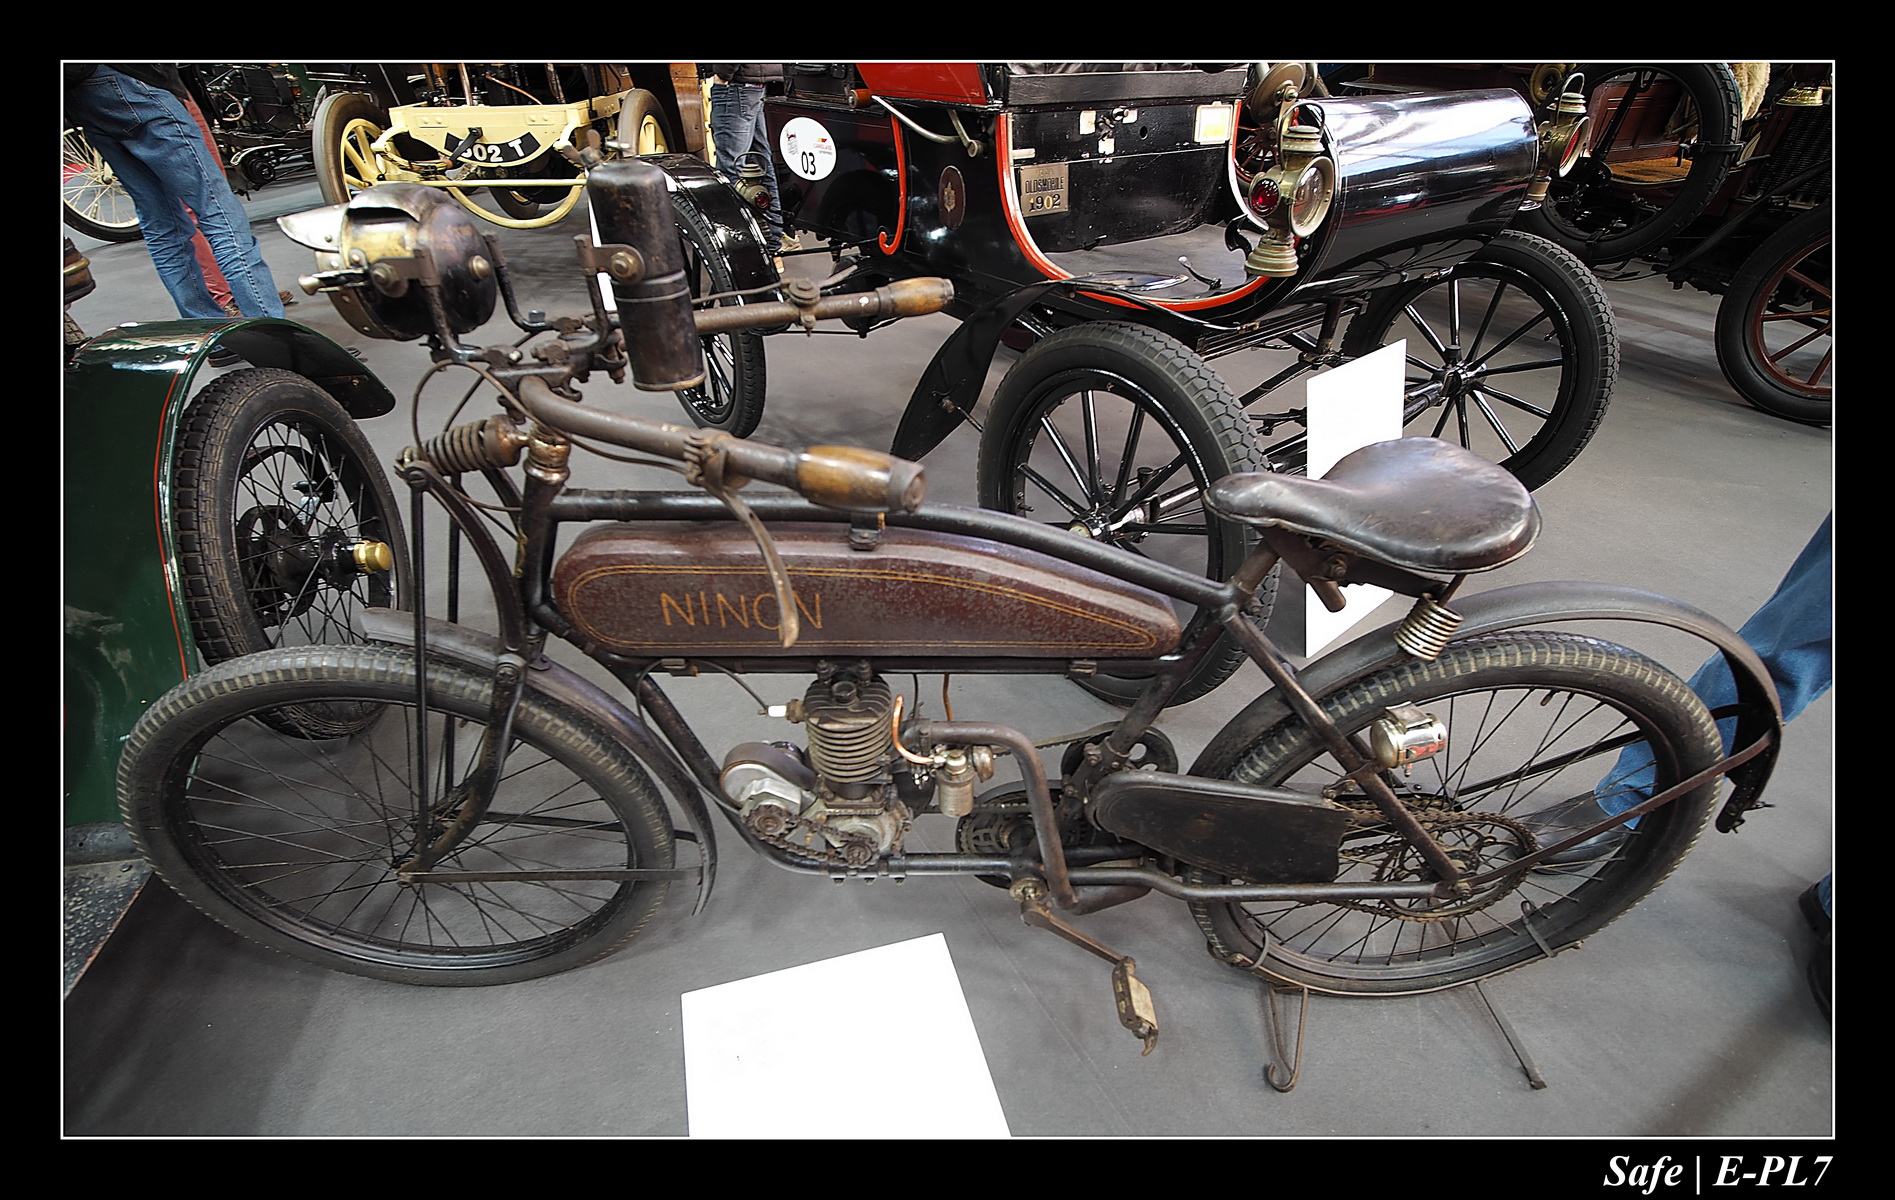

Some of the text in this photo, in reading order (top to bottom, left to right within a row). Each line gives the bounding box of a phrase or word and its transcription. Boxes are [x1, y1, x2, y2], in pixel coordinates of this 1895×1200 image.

[508, 138, 525, 158] T
[801, 150, 817, 176] 03
[1025, 176, 1065, 194] OLDSMOBILE
[1029, 193, 1061, 212] 1902
[660, 591, 823, 631] NINON
